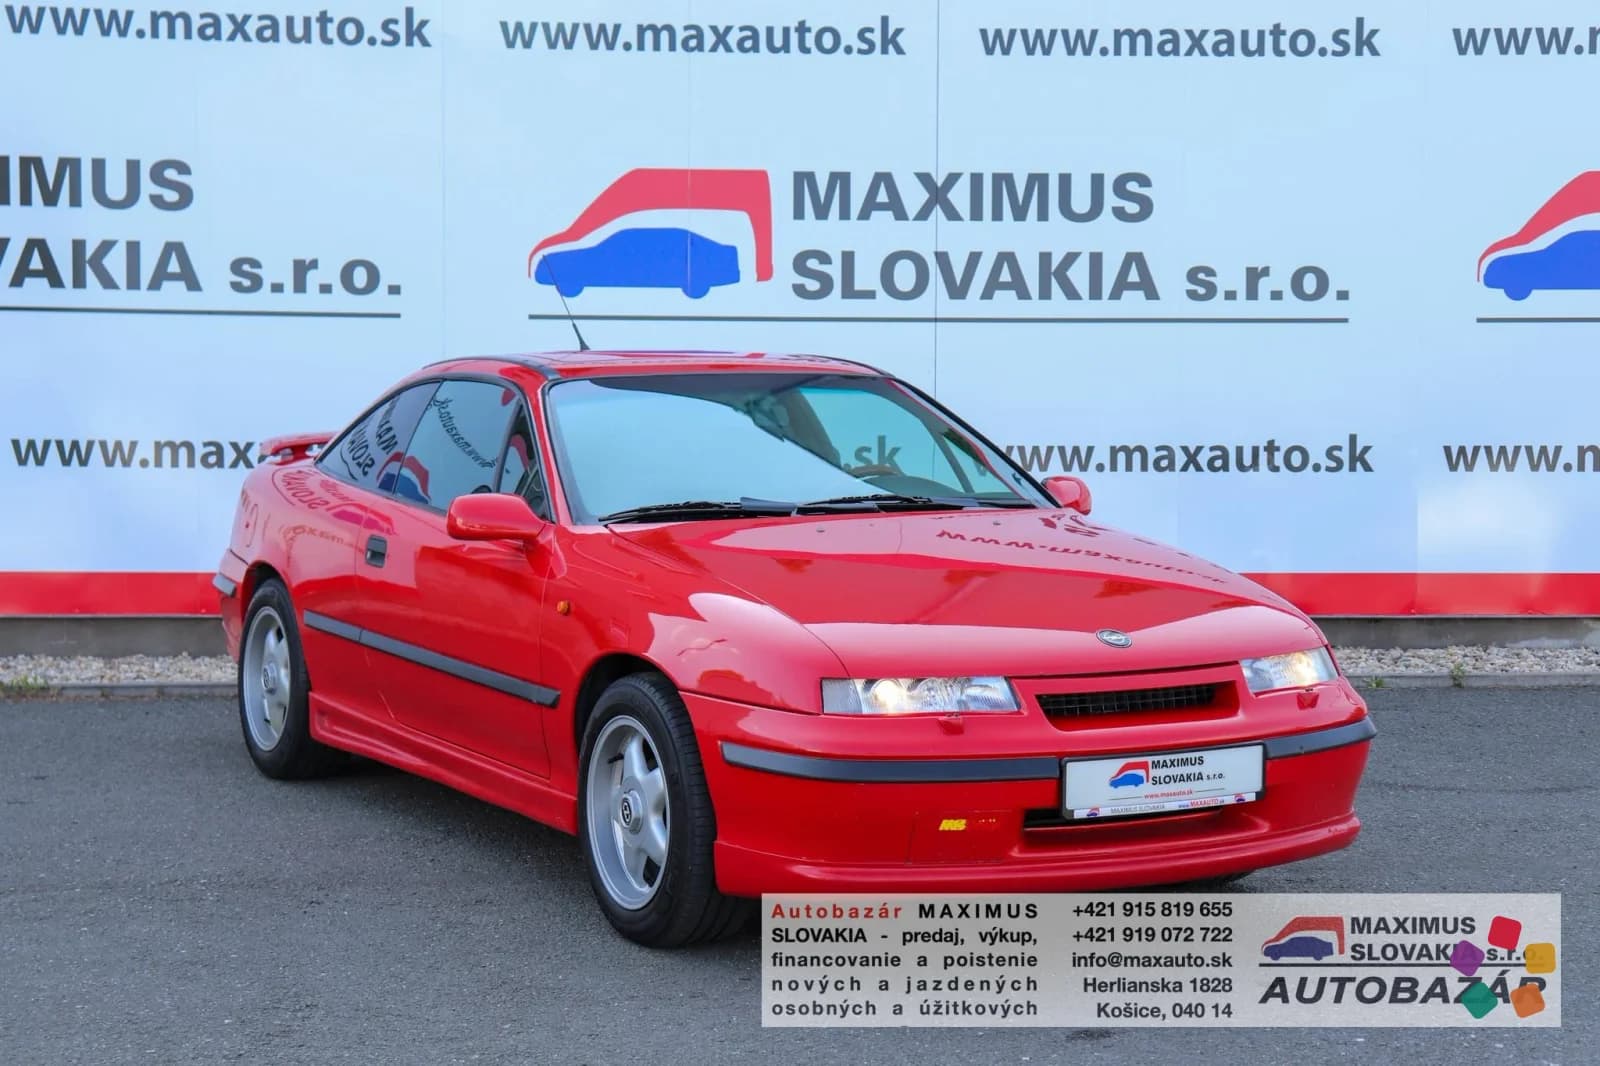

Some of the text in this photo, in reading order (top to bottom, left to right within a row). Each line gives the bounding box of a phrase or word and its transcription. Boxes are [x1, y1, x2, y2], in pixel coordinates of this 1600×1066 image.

[4, 5, 432, 47] www.maxauto.sk
[500, 15, 906, 55] www.maxauto.sk
[979, 17, 1381, 57] www.maxauto.sk
[792, 171, 1154, 222] MAXIMUS
[0, 237, 402, 296] AKIA s.r.o.
[791, 249, 1350, 301] SLOVAKIA s.r.o.
[11, 438, 265, 471] www.max
[1151, 755, 1205, 771] MAXIMUS
[1151, 771, 1225, 786] SLOVAKIA s.r.o.
[1144, 789, 1193, 800] www.maxauto.sk
